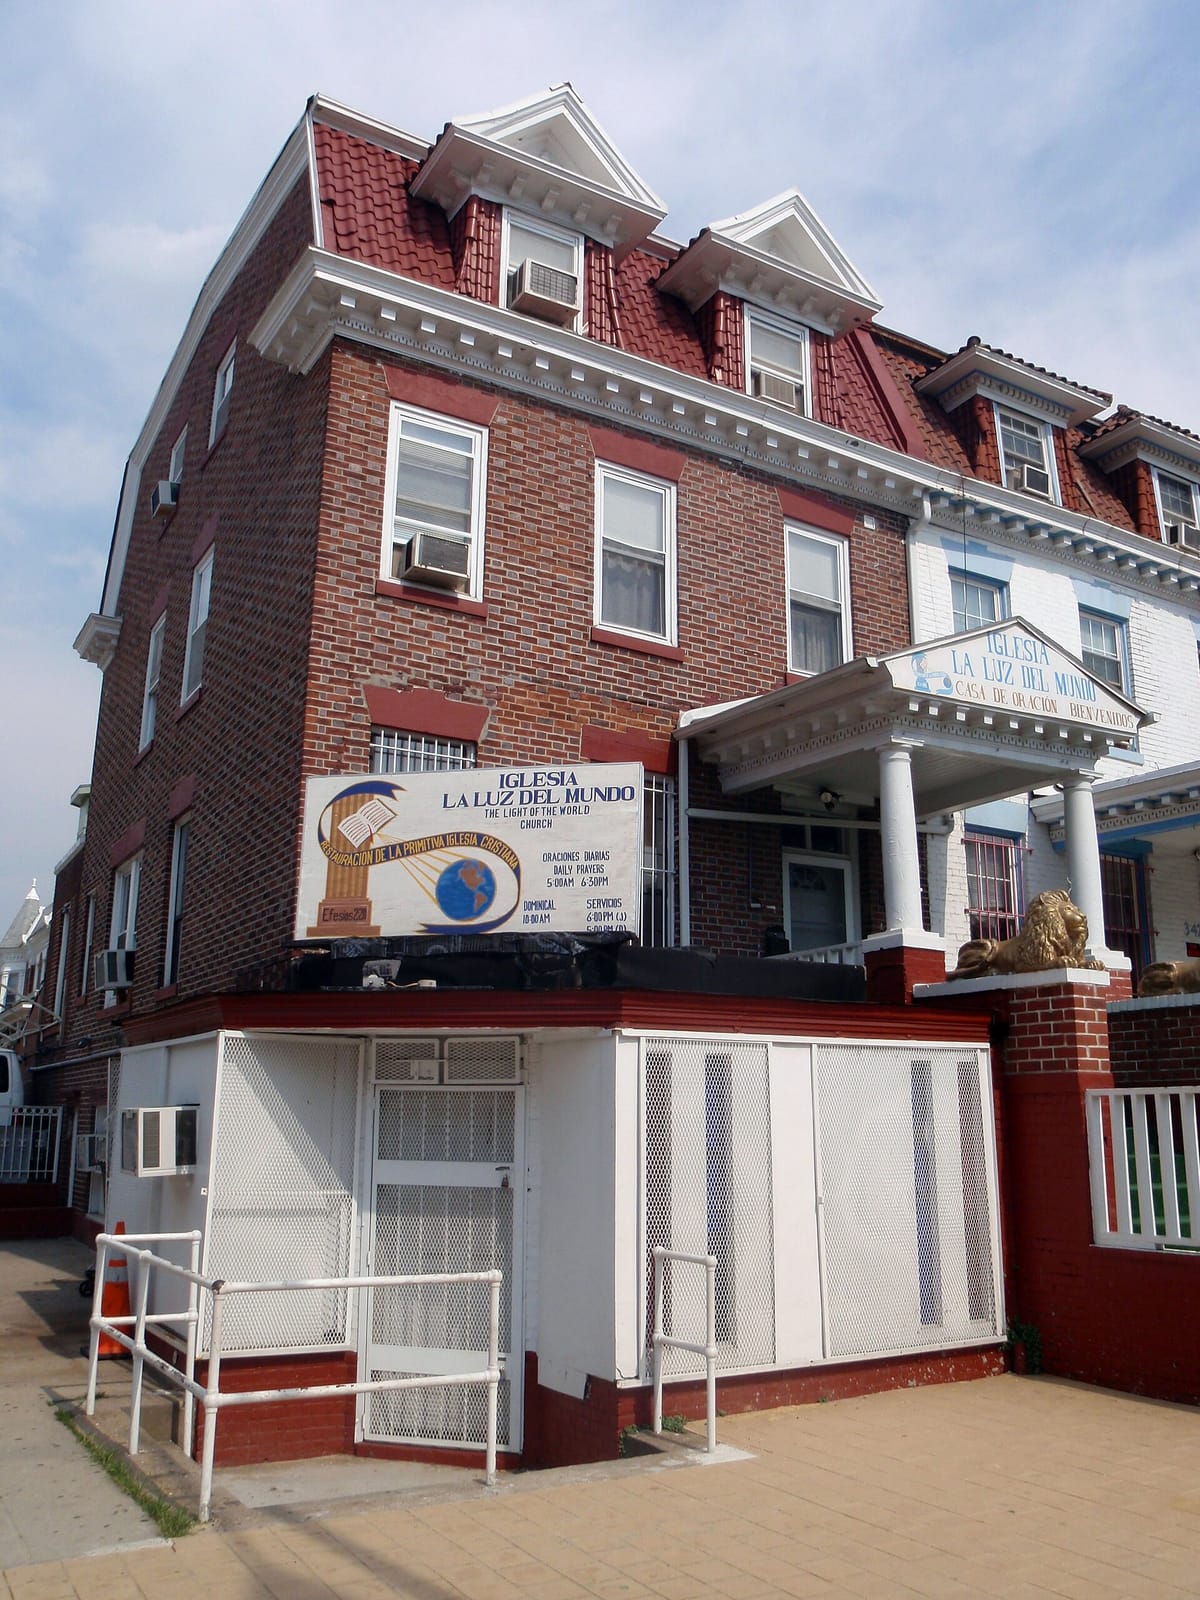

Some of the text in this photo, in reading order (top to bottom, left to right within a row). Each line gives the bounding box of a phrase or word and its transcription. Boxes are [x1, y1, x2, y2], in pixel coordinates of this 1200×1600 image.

[987, 632, 1050, 666] IGLESIA
[951, 650, 1097, 703] LA LUZ DEL MUNDO
[955, 680, 985, 700] CASA
[993, 687, 1009, 705] DE
[1069, 702, 1134, 729] BIENVENIDOS
[499, 771, 579, 789] IGLESIA
[442, 785, 635, 809] LA LUZ DEL MUNDO
[484, 805, 590, 819] THE LIGHT OF THE WORLD
[520, 819, 553, 830] CHURCH
[375, 851, 386, 864] DE
[389, 847, 403, 860] LA
[403, 836, 446, 855] PRIMITIVA
[446, 833, 478, 847] IGLESIA
[480, 836, 518, 870] CRISTIANA
[542, 850, 610, 863] ORACIONES DIARIAS
[553, 864, 605, 876] DAILY PRAYERS
[580, 876, 609, 887] 6:30PM
[523, 900, 556, 911] DOMINICAL
[586, 898, 622, 909] SERVICIOS
